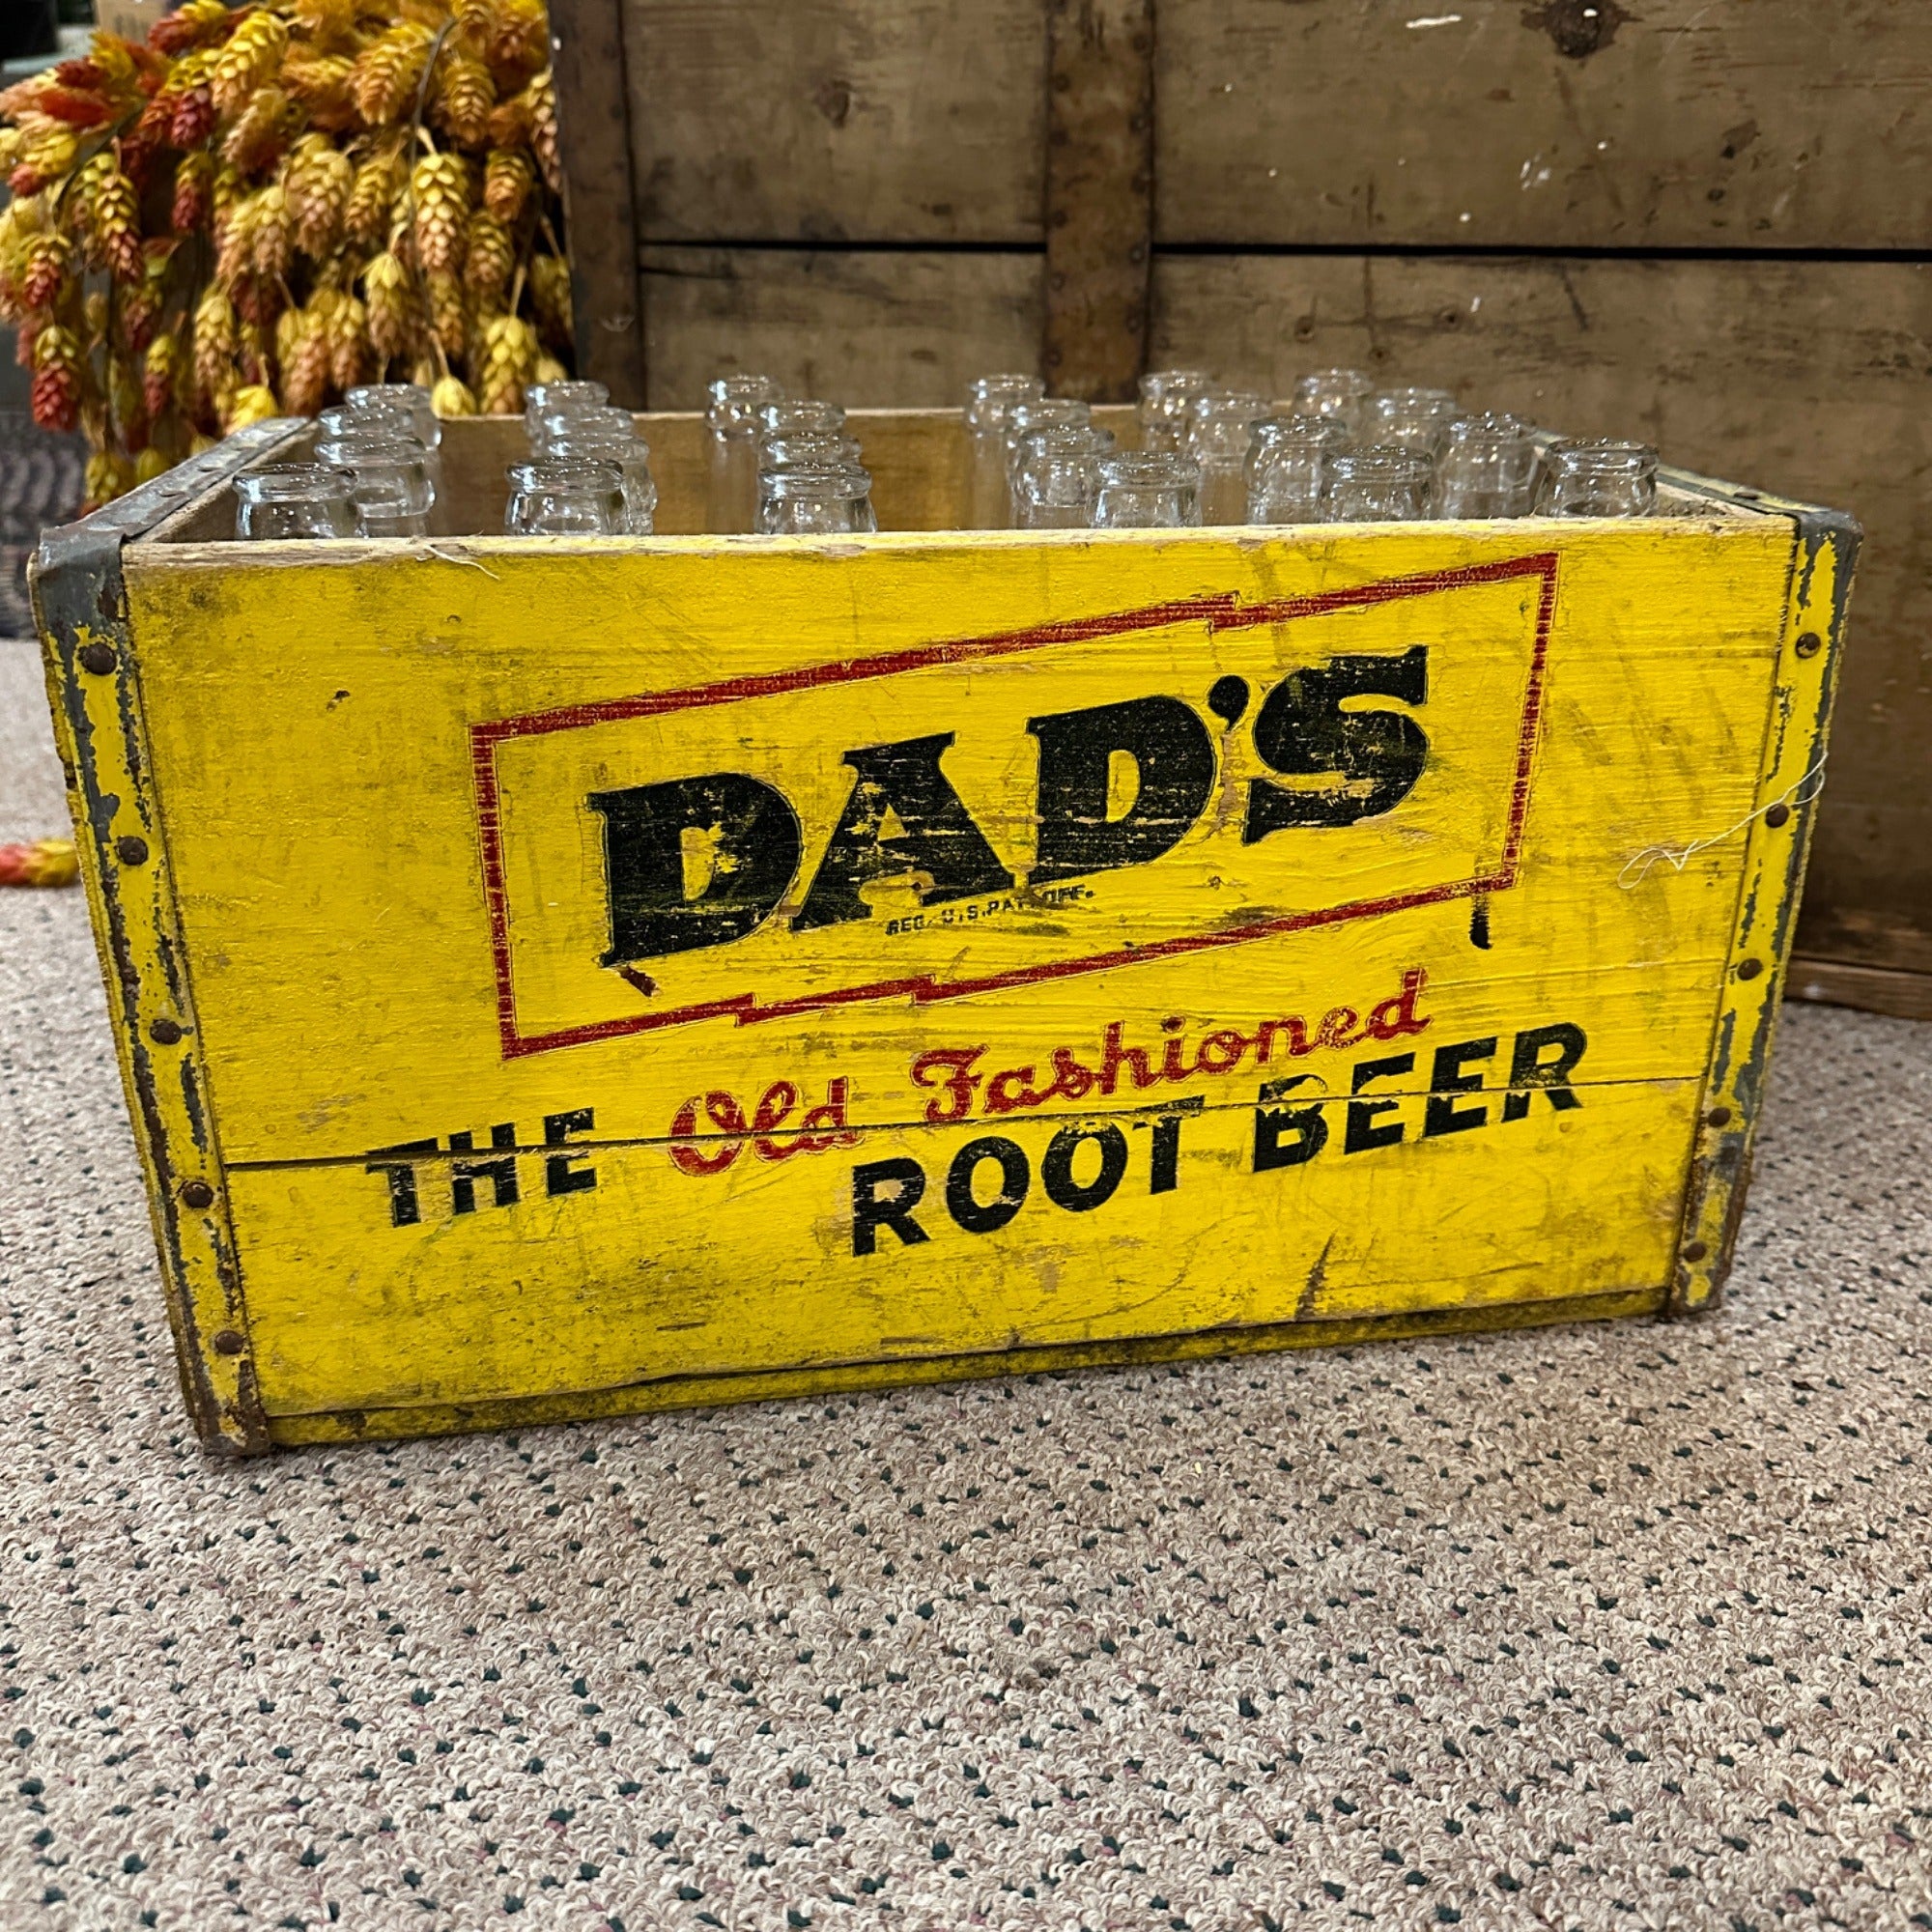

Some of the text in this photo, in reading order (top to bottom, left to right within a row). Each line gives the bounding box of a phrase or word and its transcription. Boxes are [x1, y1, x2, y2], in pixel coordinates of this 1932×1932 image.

[588, 645, 1430, 967] DAD'S
[367, 968, 1430, 1228] THE Old Fashioned
[853, 1021, 1588, 1257] ROOT BEER
